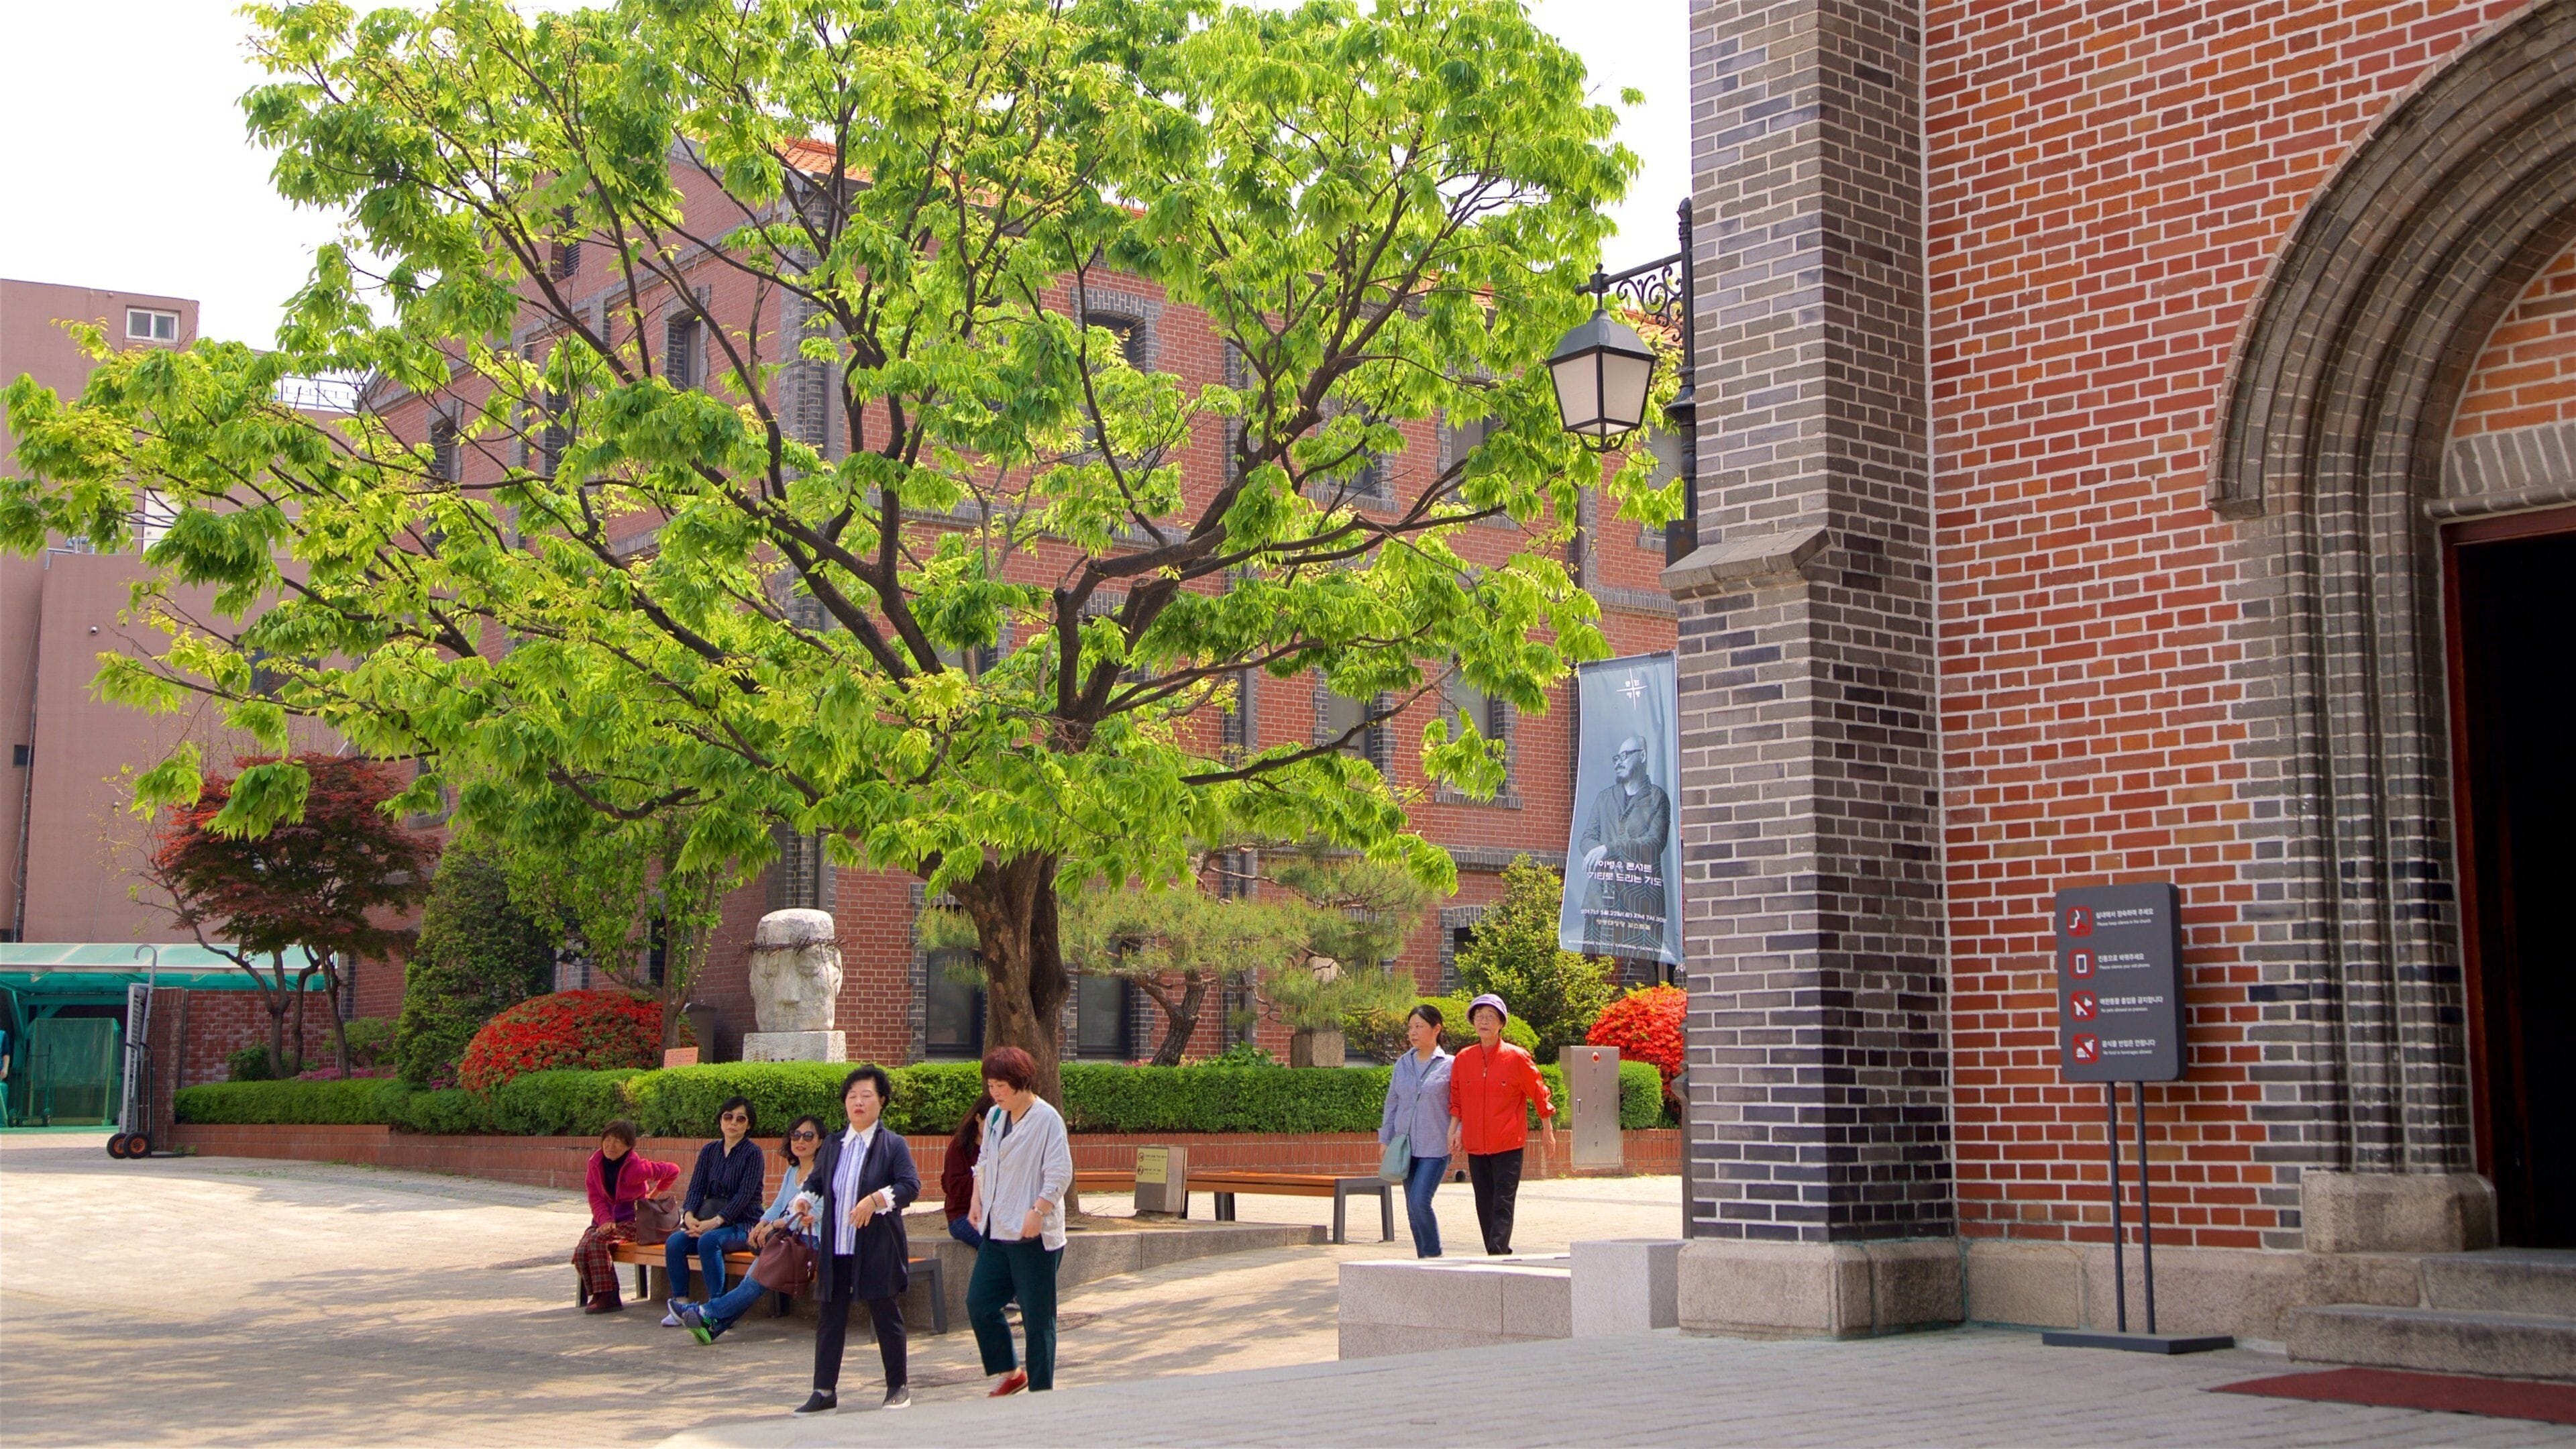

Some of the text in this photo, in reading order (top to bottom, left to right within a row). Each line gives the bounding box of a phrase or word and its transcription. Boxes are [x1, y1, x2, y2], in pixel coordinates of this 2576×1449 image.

[1598, 860, 1652, 873] 이병우 콘서트
[1616, 873, 1642, 883] 드리는
[2138, 908, 2154, 916] 주세요
